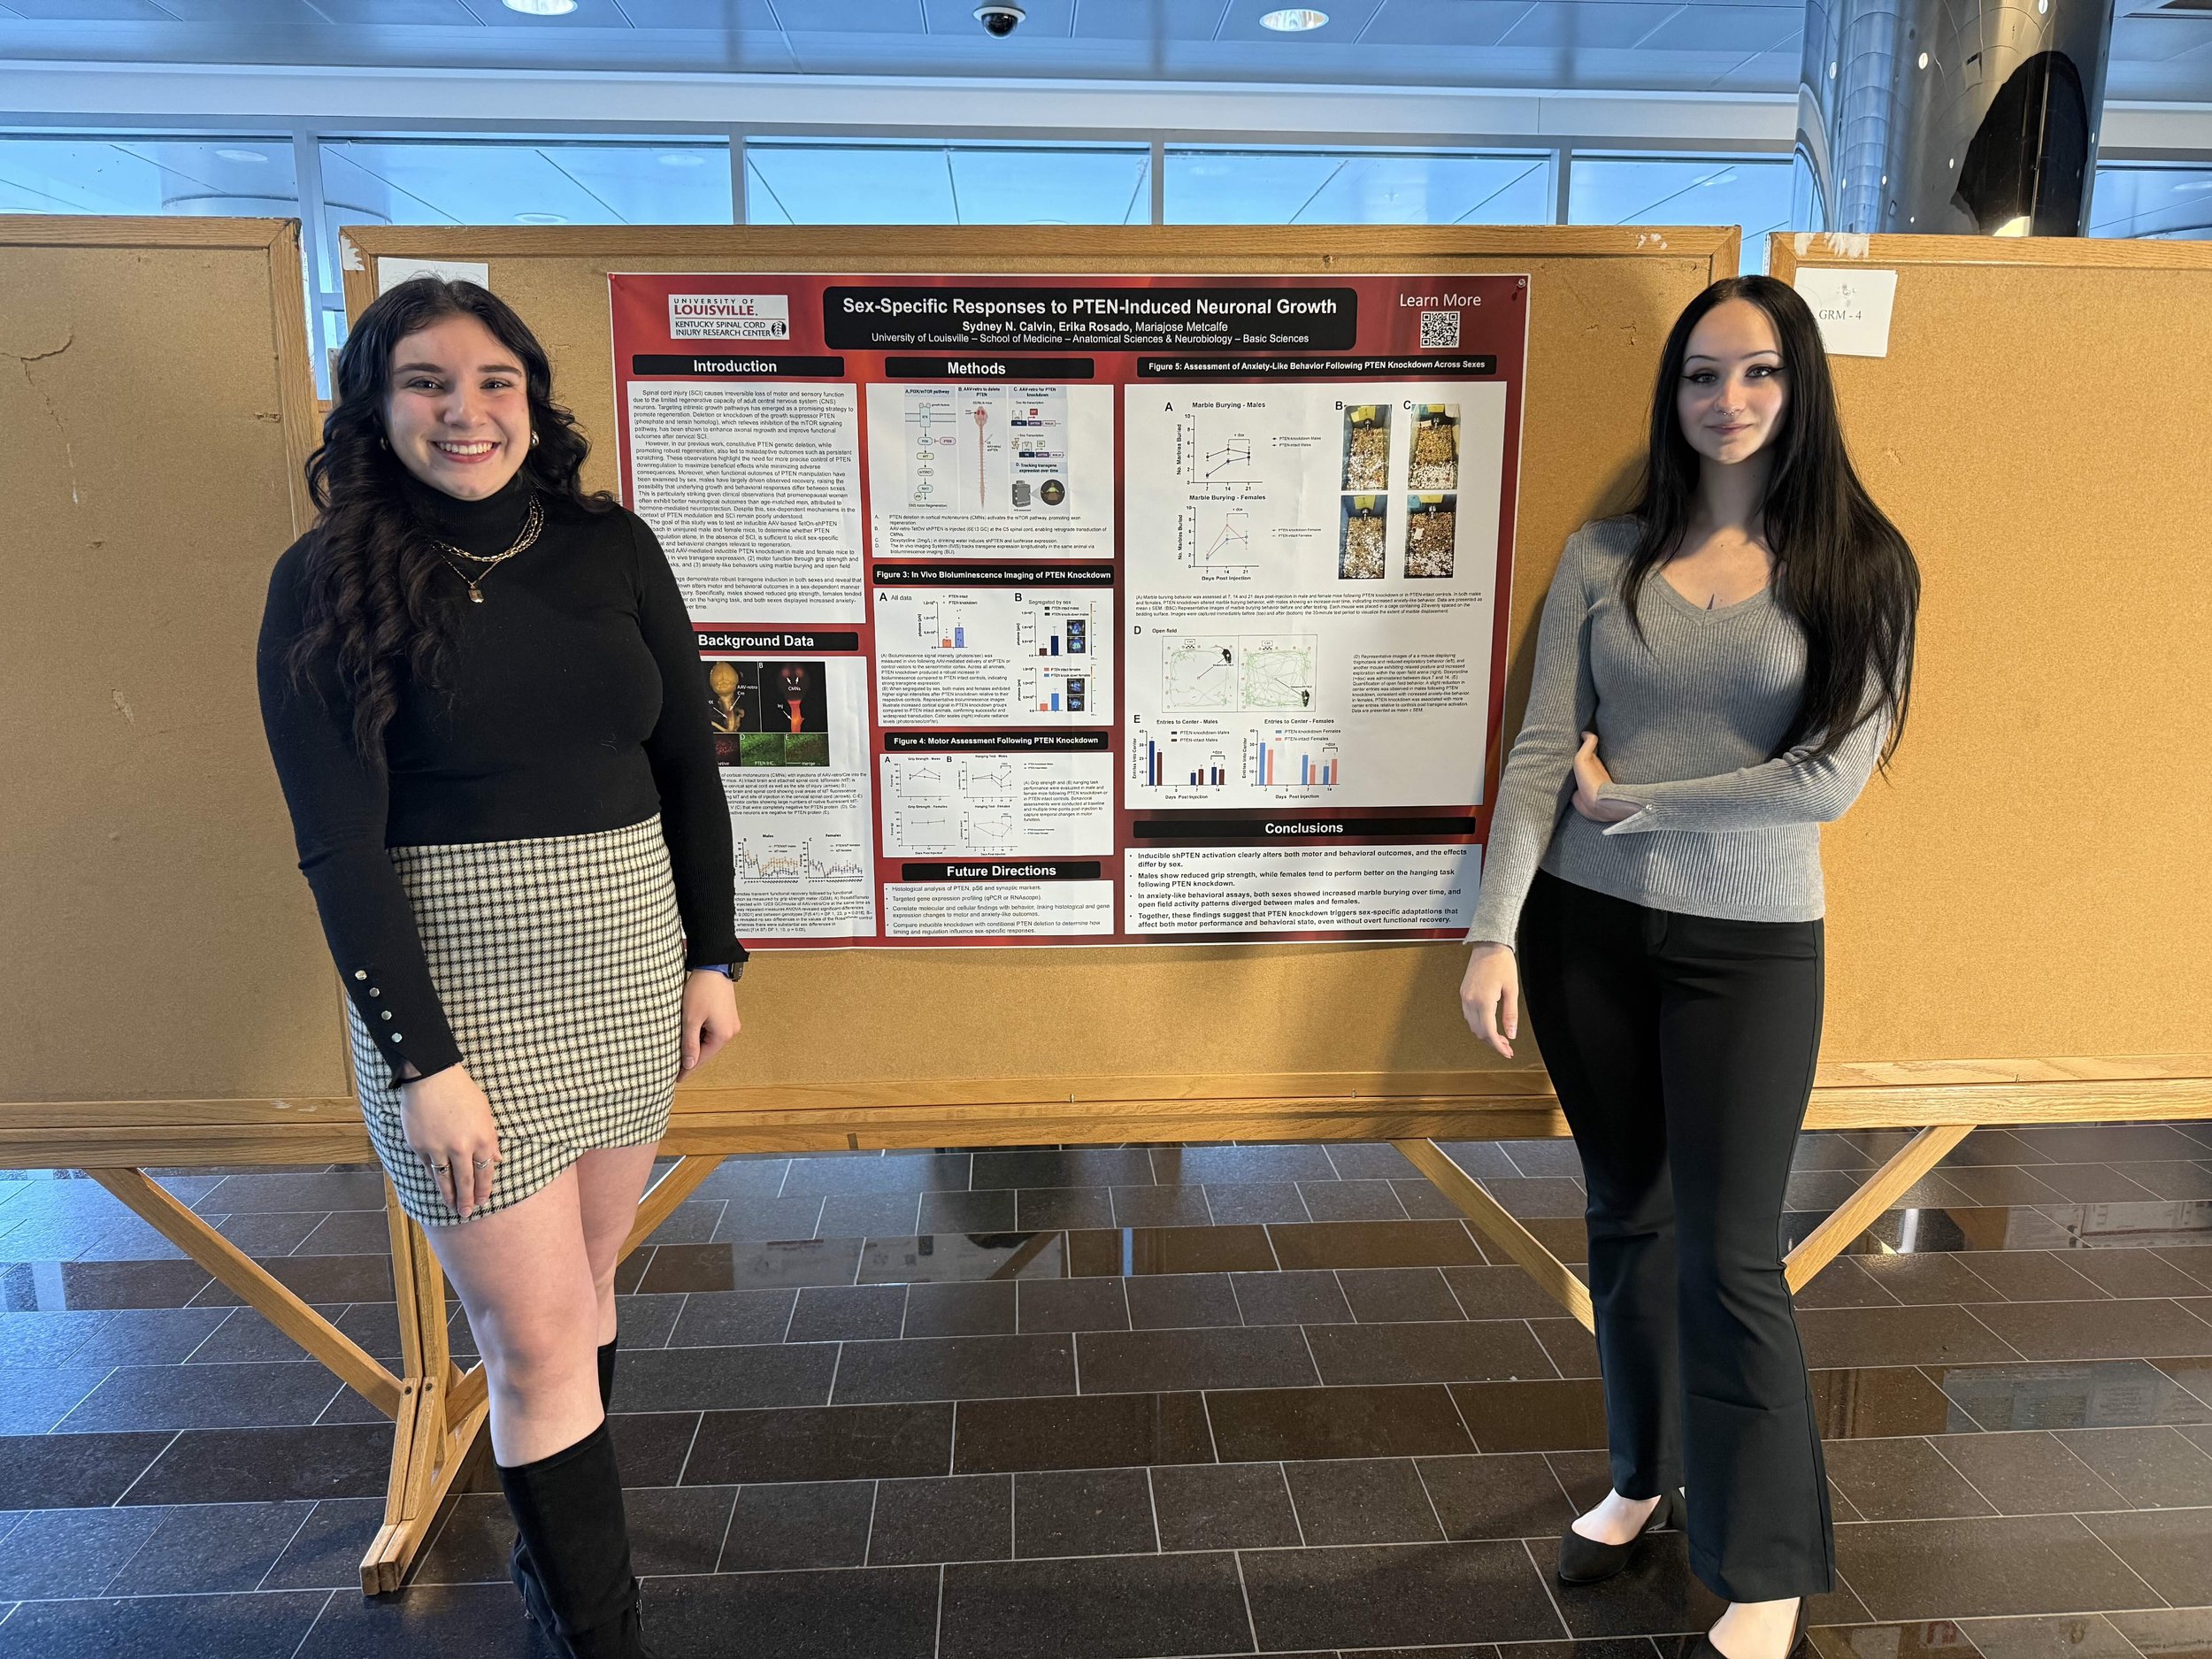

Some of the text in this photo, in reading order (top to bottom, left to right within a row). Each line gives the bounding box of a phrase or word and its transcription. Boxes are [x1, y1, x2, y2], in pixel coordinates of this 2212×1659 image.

[1400, 293, 1481, 306] Learn More
[674, 304, 757, 316] LOUISVILLE.
[843, 297, 1336, 317] Sex-Specific Responses to PTEN-Induced Neuronal Growth
[1818, 310, 1846, 320] GRM
[1855, 311, 1862, 319] 4
[675, 320, 715, 329] KENTUCKY
[716, 321, 741, 330] SPINAL
[962, 321, 1228, 334] Sydney N. Calvin, Erika Rosado, Mariajose Metcalfe
[872, 333, 915, 343] University
[918, 333, 926, 342] of
[928, 333, 968, 342] Louisville
[980, 332, 1010, 342] School
[1012, 334, 1020, 342] of
[1024, 334, 1062, 342] Medicine
[1072, 334, 1120, 342] Anatomical
[1124, 333, 1164, 343] Sciences
[1175, 334, 1232, 345] Neurobiology
[1243, 334, 1266, 342] Basic
[1270, 334, 1309, 342] Sciences
[694, 359, 777, 372] Introduction
[948, 362, 1005, 374] Methods
[1148, 362, 1173, 372] Figure
[1240, 362, 1288, 372] Anxiety-Like
[1325, 361, 1363, 371] Following
[1164, 402, 1172, 411] A
[1335, 401, 1343, 411] B
[1403, 400, 1411, 411] C
[876, 571, 901, 580] Figure
[1015, 593, 1022, 602] B
[1133, 626, 1141, 634] D
[697, 634, 814, 649] Background Data
[1133, 714, 1141, 723] E
[894, 737, 918, 746] Figure
[1265, 822, 1343, 833] Conclusions
[948, 864, 1056, 877] Future Directions
